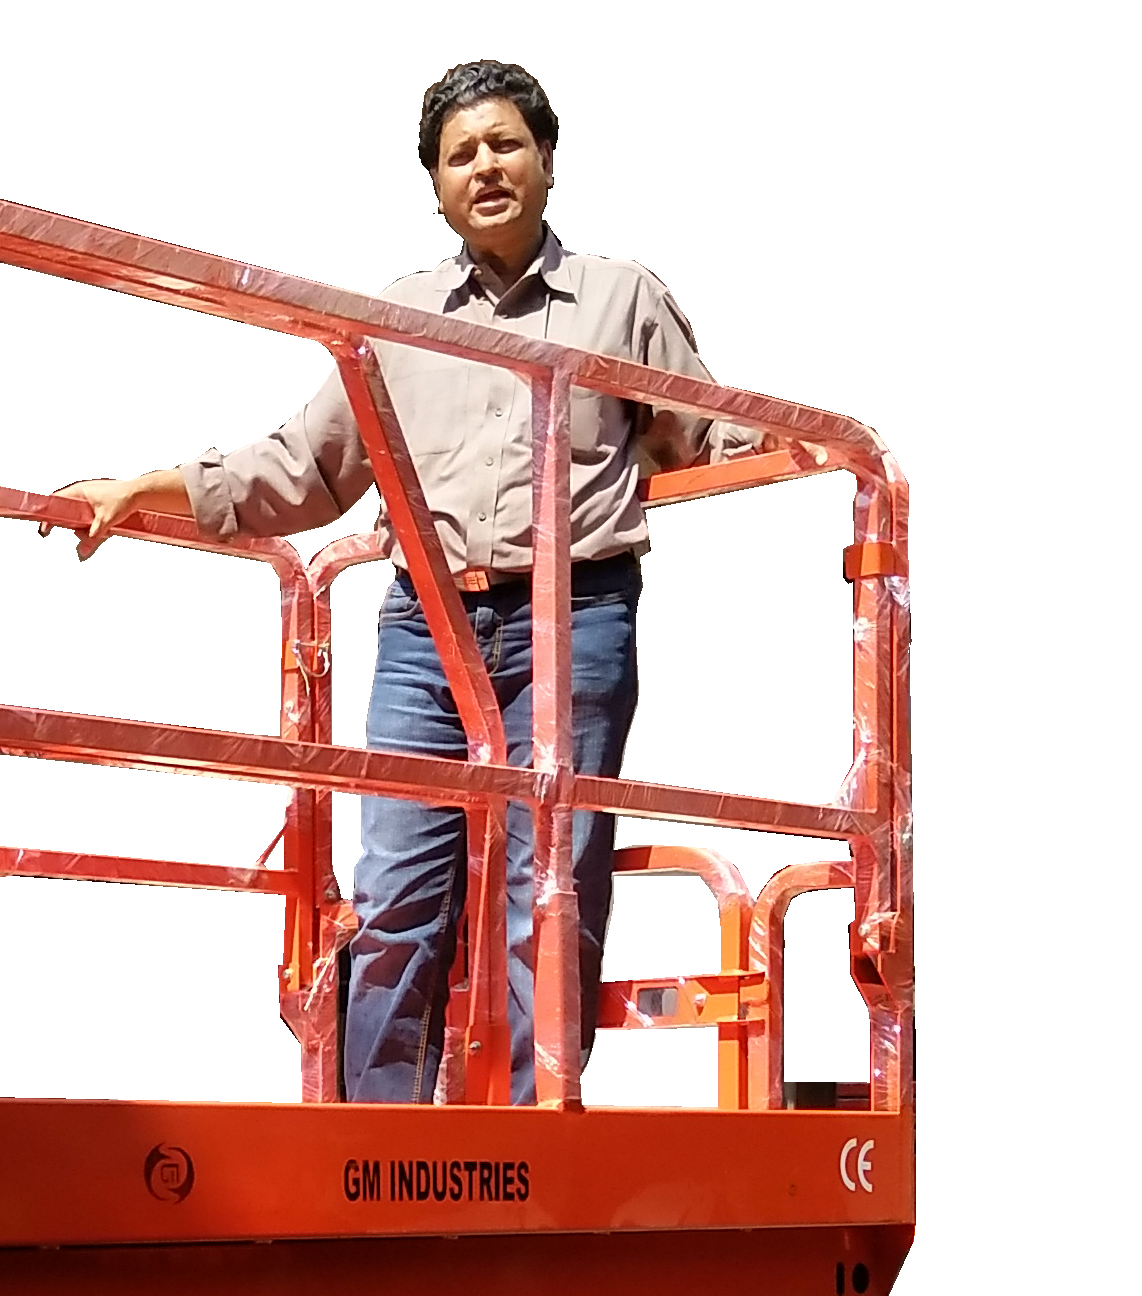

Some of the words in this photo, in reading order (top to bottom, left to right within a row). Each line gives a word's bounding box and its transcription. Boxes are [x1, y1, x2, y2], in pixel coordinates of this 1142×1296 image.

[344, 1159, 381, 1201] GM
[390, 1160, 530, 1202] INDUSTRIES
[840, 1137, 875, 1193] CE
